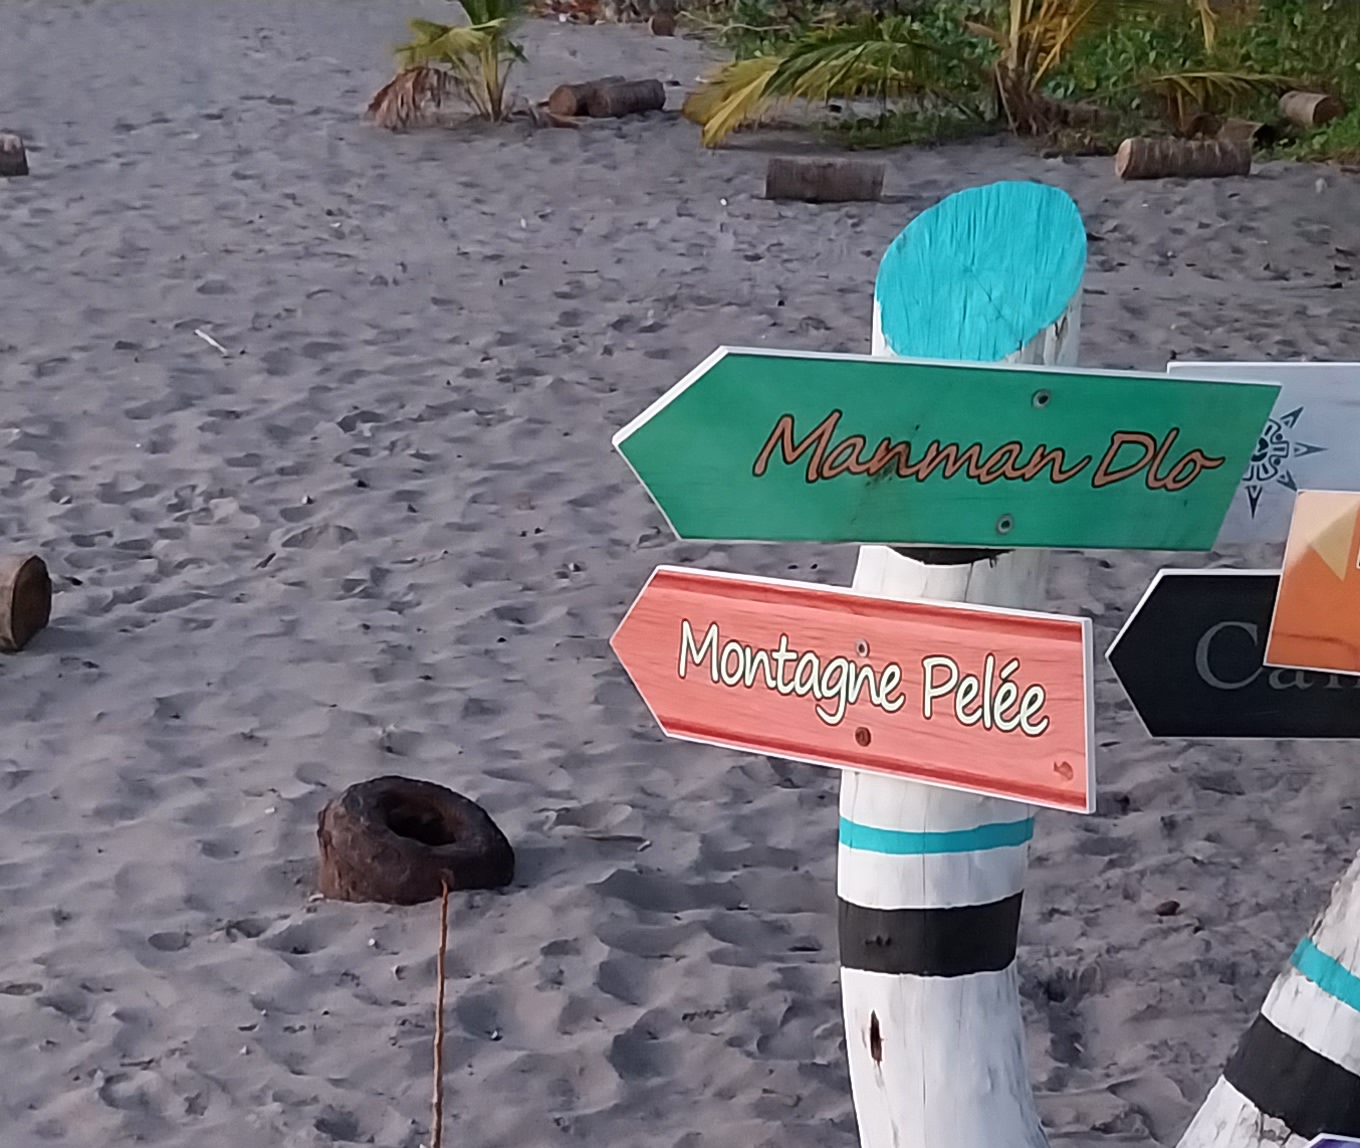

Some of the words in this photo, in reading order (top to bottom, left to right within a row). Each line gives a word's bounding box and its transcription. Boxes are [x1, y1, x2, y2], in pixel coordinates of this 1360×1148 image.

[752, 410, 1090, 483] Manman
[1090, 427, 1224, 492] Dlo
[676, 619, 906, 725] Montagne
[922, 654, 1050, 736] Pelée
